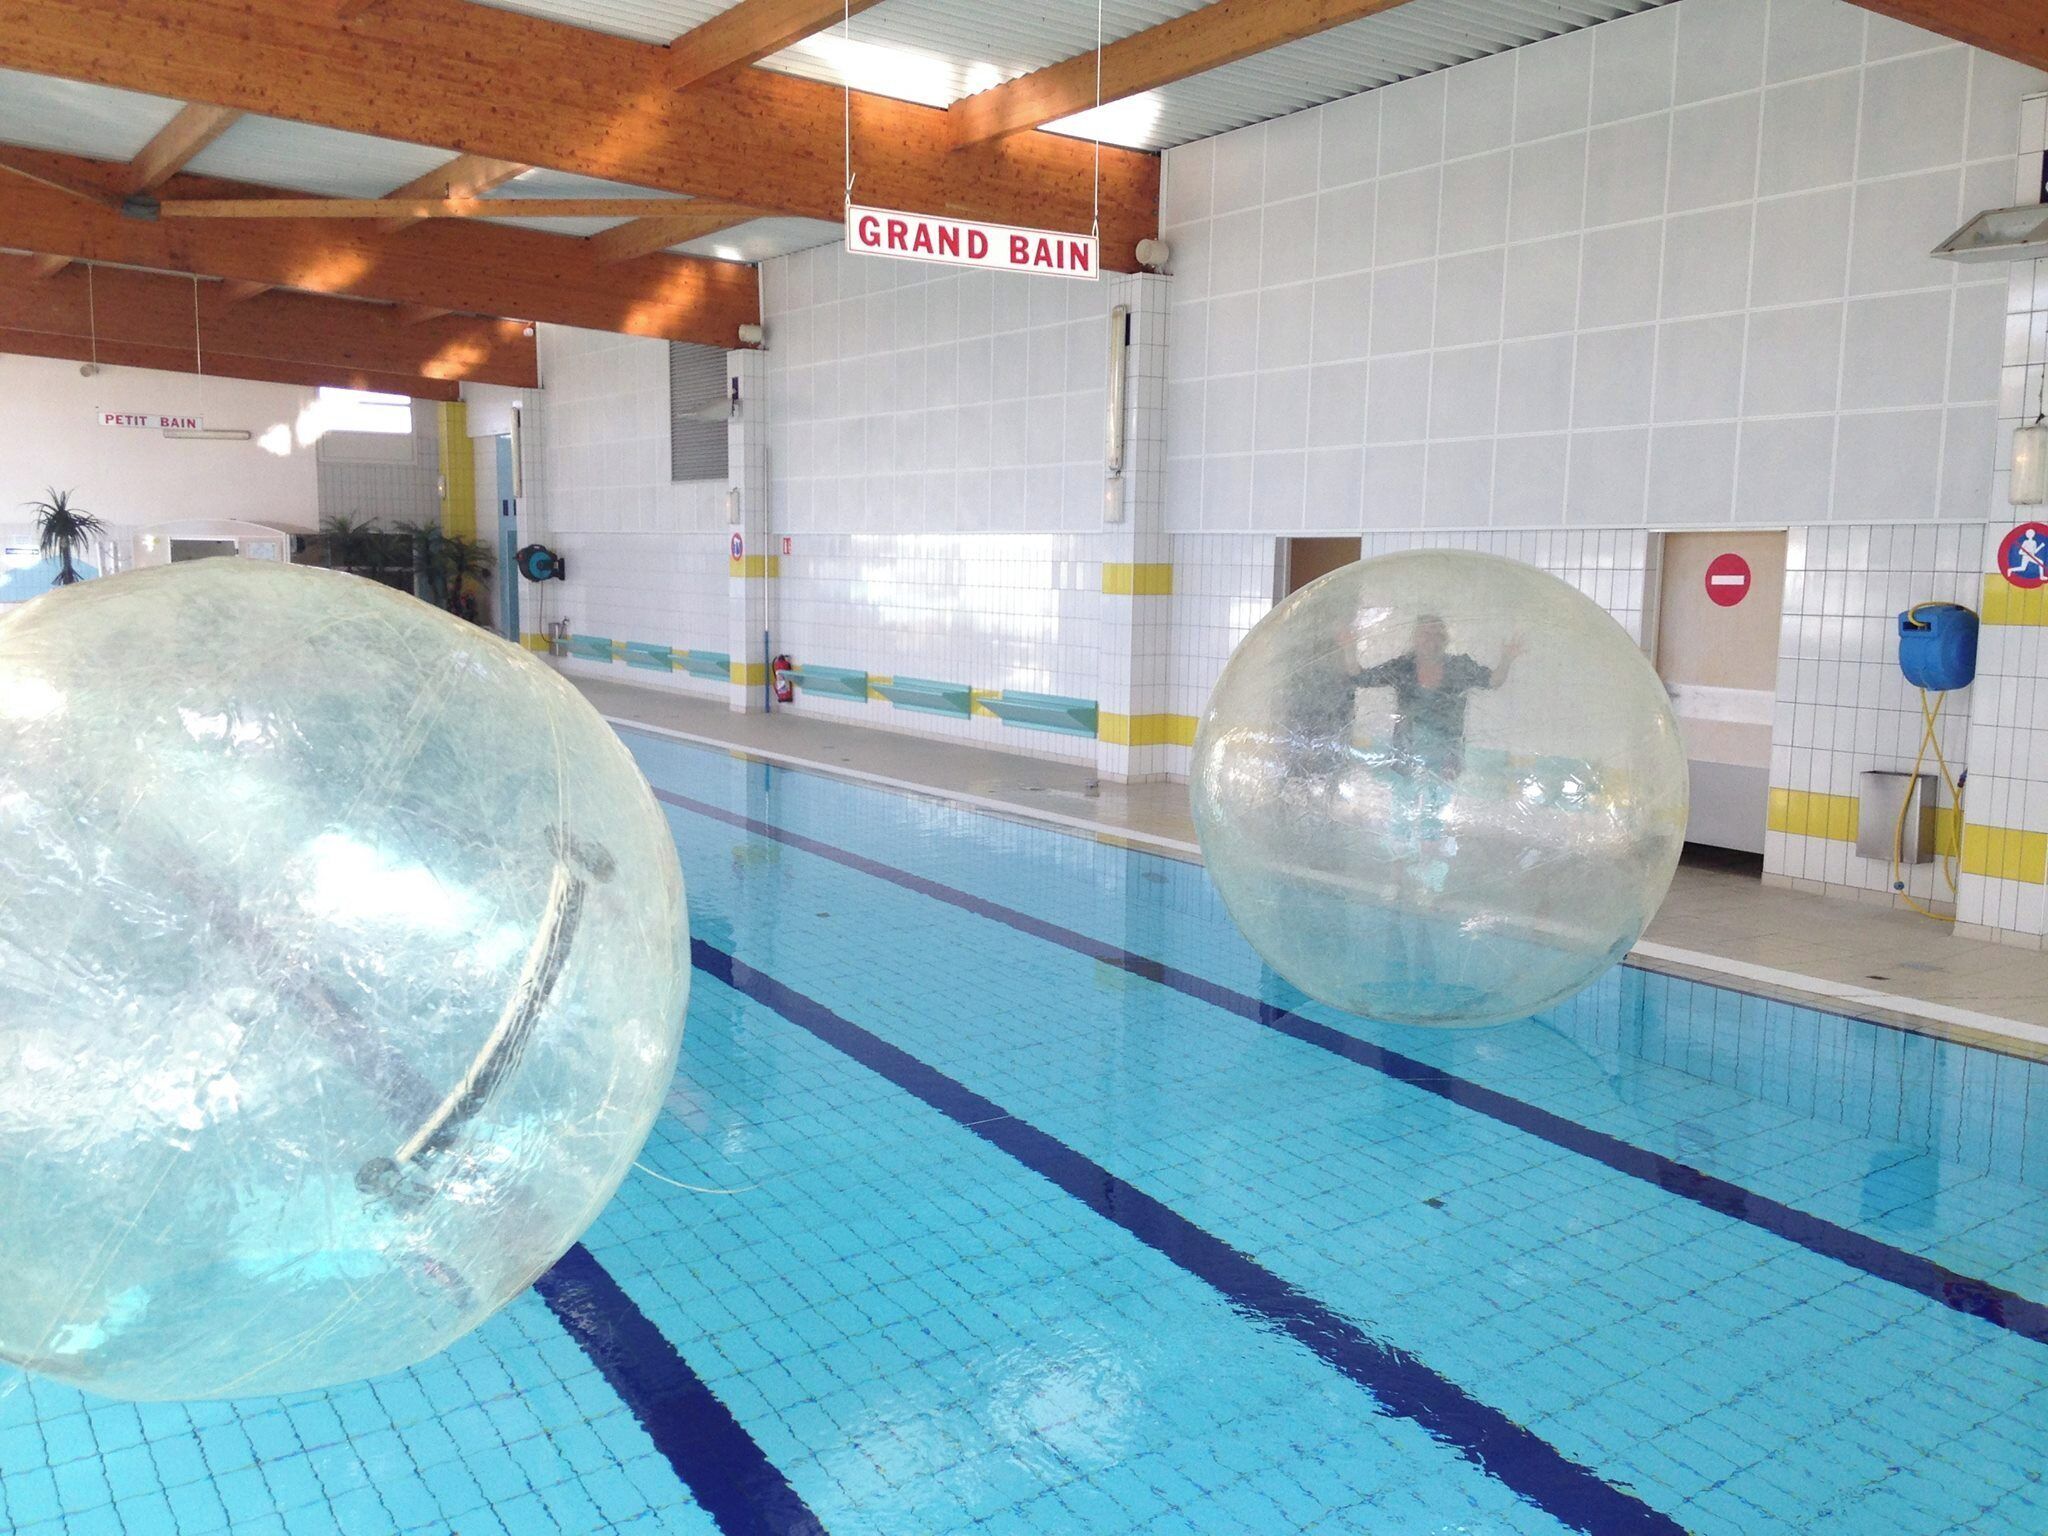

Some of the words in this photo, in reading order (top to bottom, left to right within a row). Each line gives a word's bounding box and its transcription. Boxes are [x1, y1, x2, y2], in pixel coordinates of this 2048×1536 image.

[858, 215, 988, 260] GRAND
[1009, 234, 1089, 272] BAIN
[105, 414, 147, 426] PETIT
[160, 417, 196, 429] BAIN
